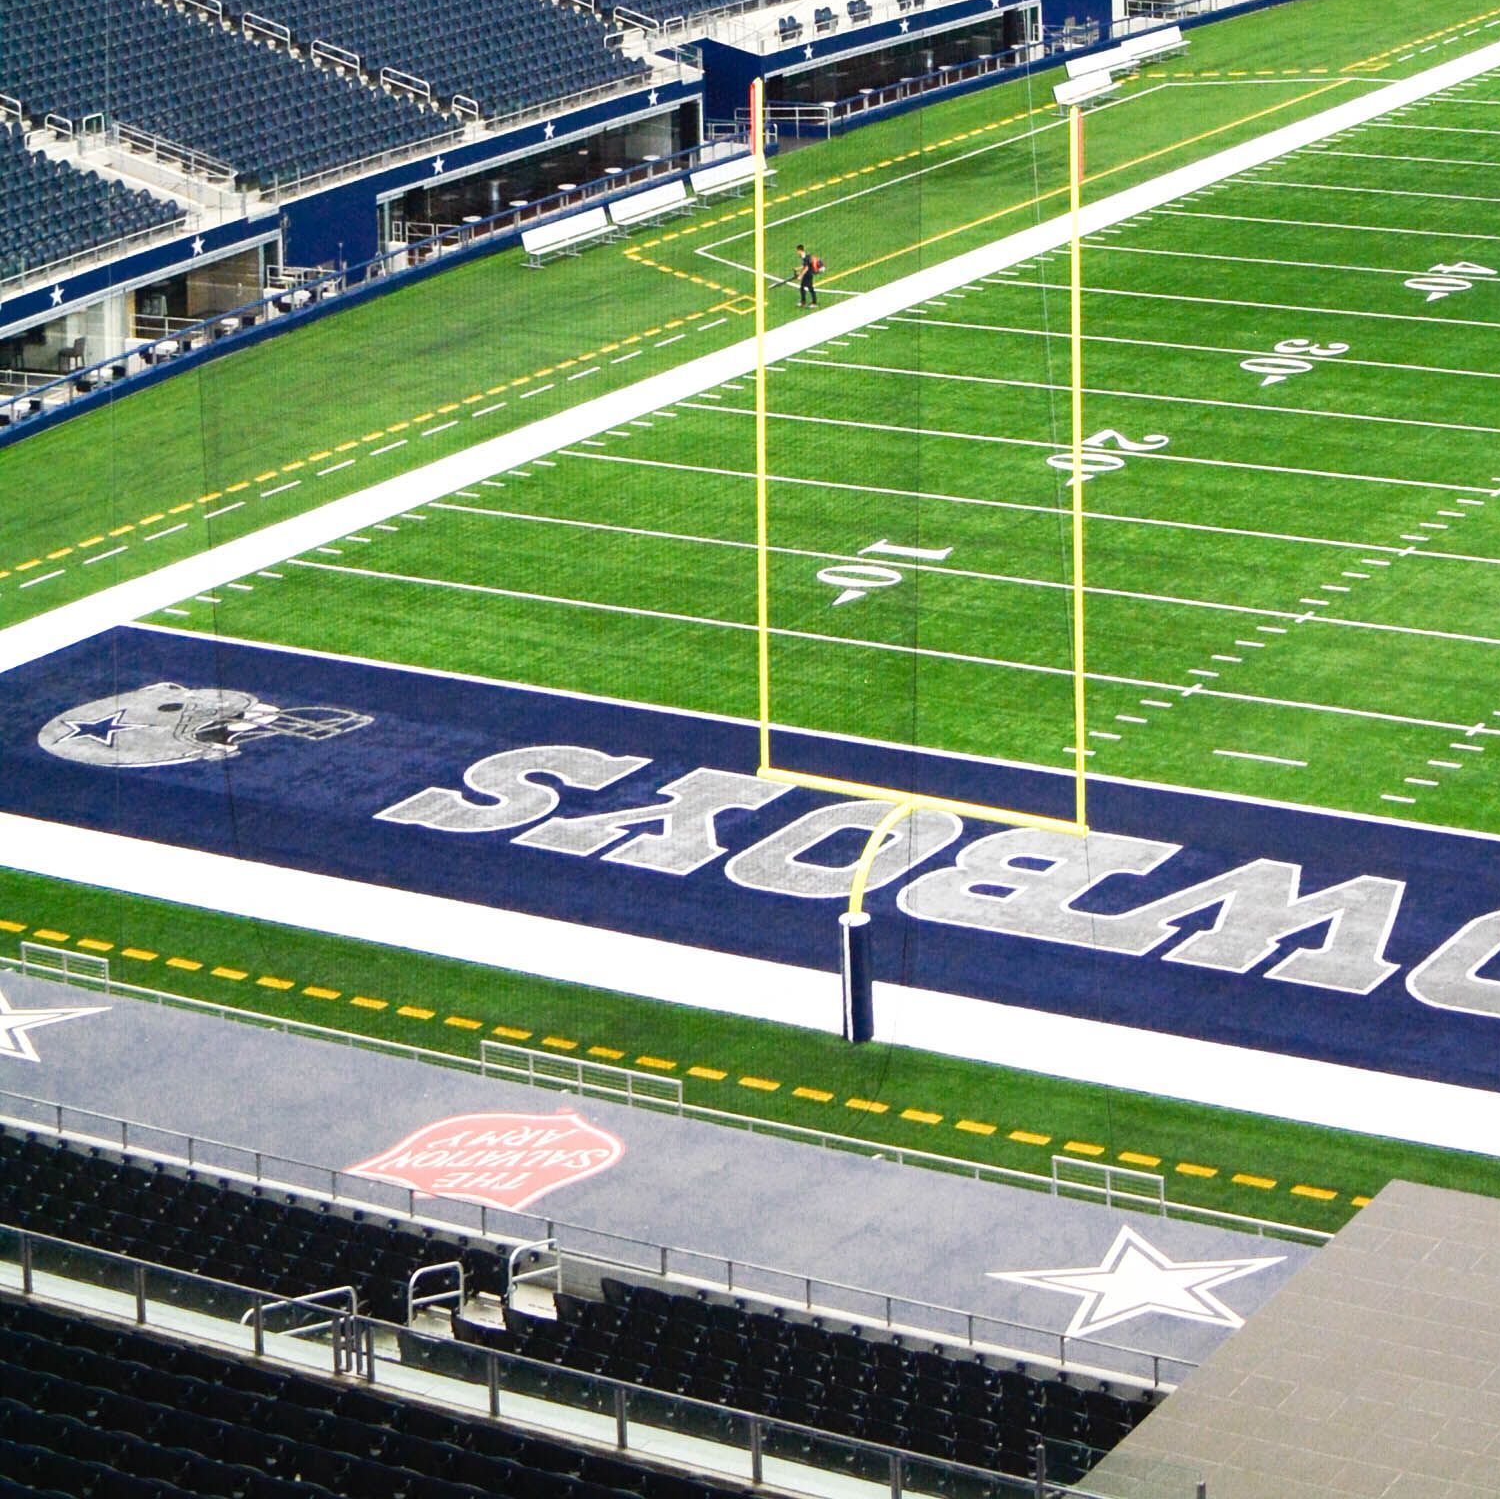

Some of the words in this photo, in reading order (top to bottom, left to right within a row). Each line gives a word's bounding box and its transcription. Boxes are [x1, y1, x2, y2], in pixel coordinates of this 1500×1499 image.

[1404, 261, 1498, 291] 40
[1240, 338, 1350, 374] 30
[1046, 429, 1170, 471] 20
[817, 539, 953, 587] 10
[427, 1125, 580, 1149] ARMY
[379, 1148, 610, 1171] SALVATION
[431, 1171, 533, 1190] THE
